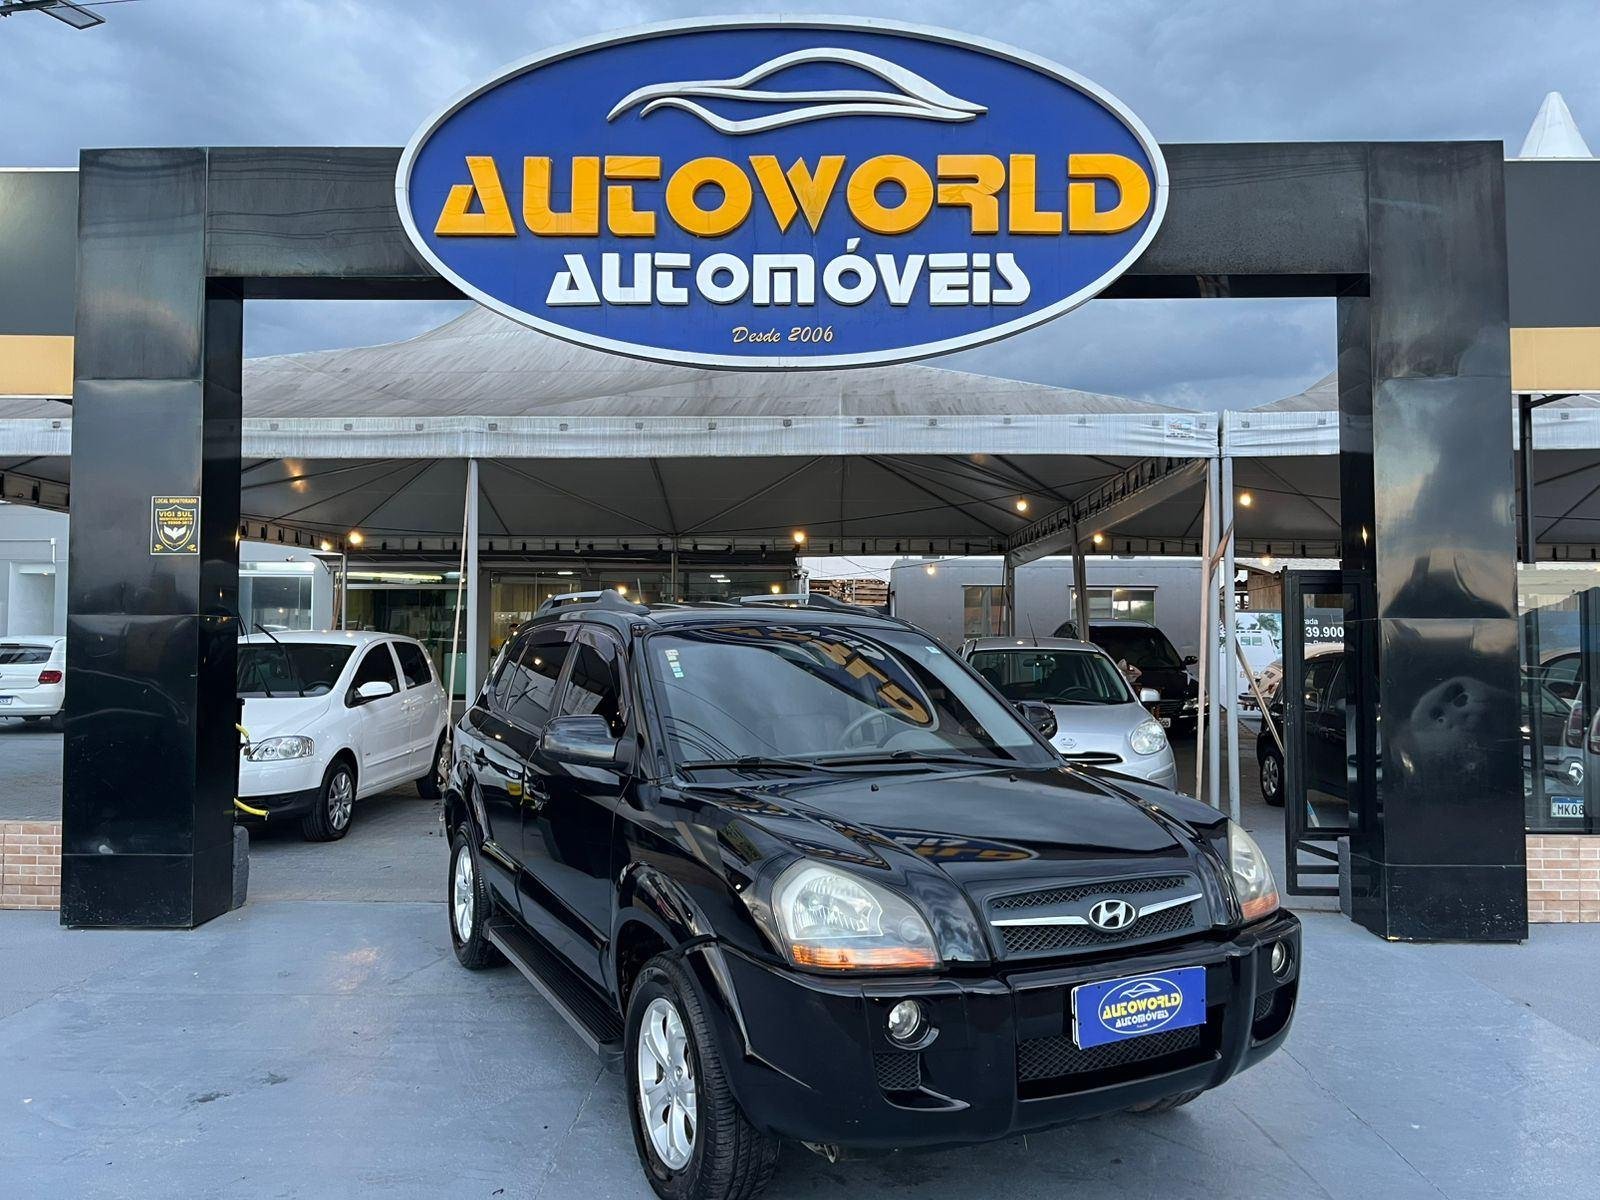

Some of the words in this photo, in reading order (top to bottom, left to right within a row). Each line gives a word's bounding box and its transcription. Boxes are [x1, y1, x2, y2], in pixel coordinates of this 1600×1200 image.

[434, 153, 1150, 237] AUTOWORLD
[546, 238, 1031, 306] AUTOMÓVEIS
[732, 326, 781, 343] Desde
[788, 325, 833, 342] 2006
[1305, 626, 1344, 638] 39.900
[1102, 992, 1181, 1020] AUTOWORLD
[1115, 1009, 1170, 1028] AUTOMÓVEIS
